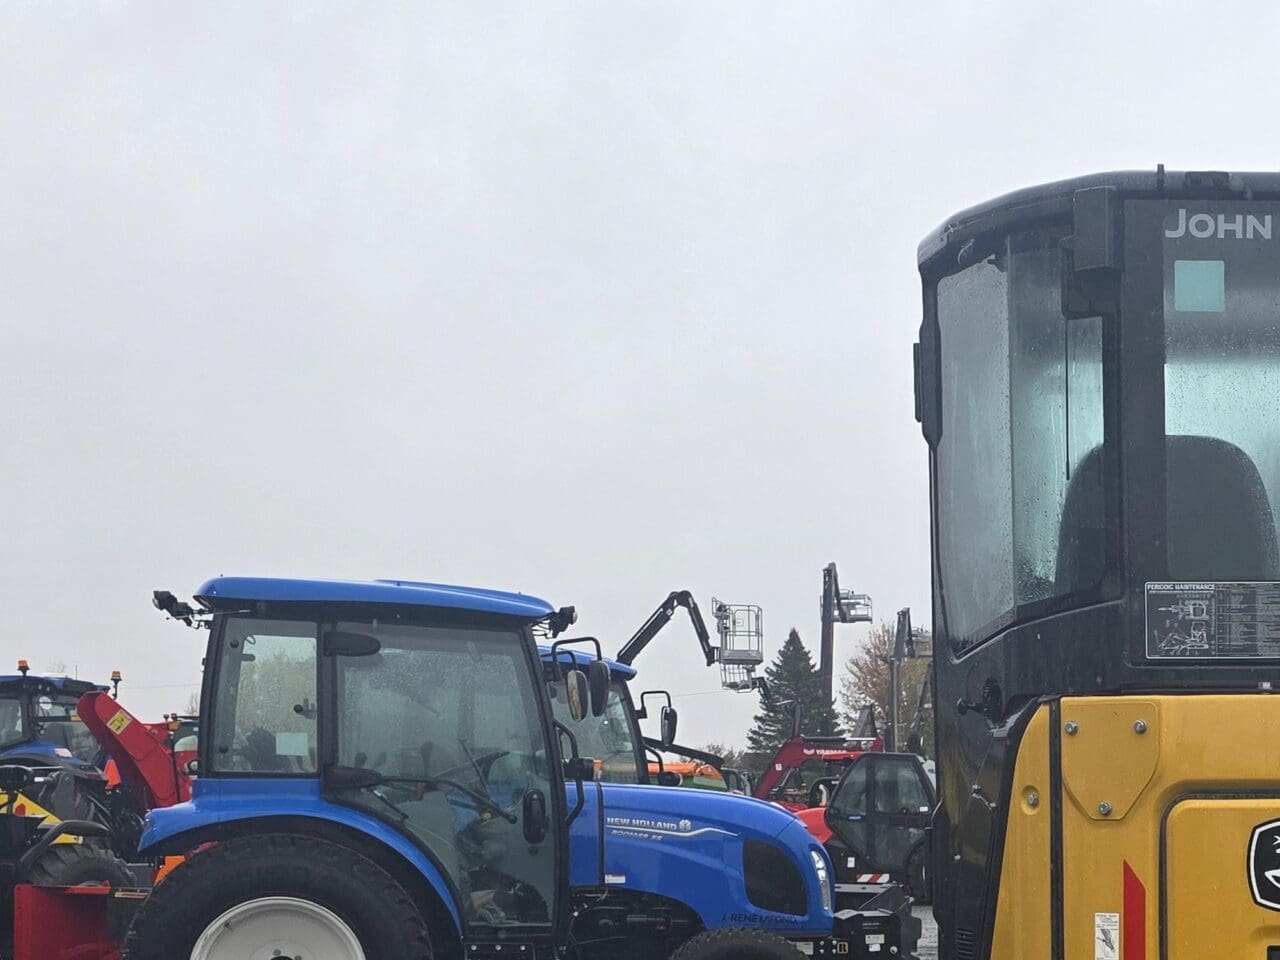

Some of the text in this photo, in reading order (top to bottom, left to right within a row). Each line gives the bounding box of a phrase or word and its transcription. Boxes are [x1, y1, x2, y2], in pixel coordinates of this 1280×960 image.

[1165, 208, 1272, 239] JOHN
[606, 817, 677, 830] NEW HOLLAND
